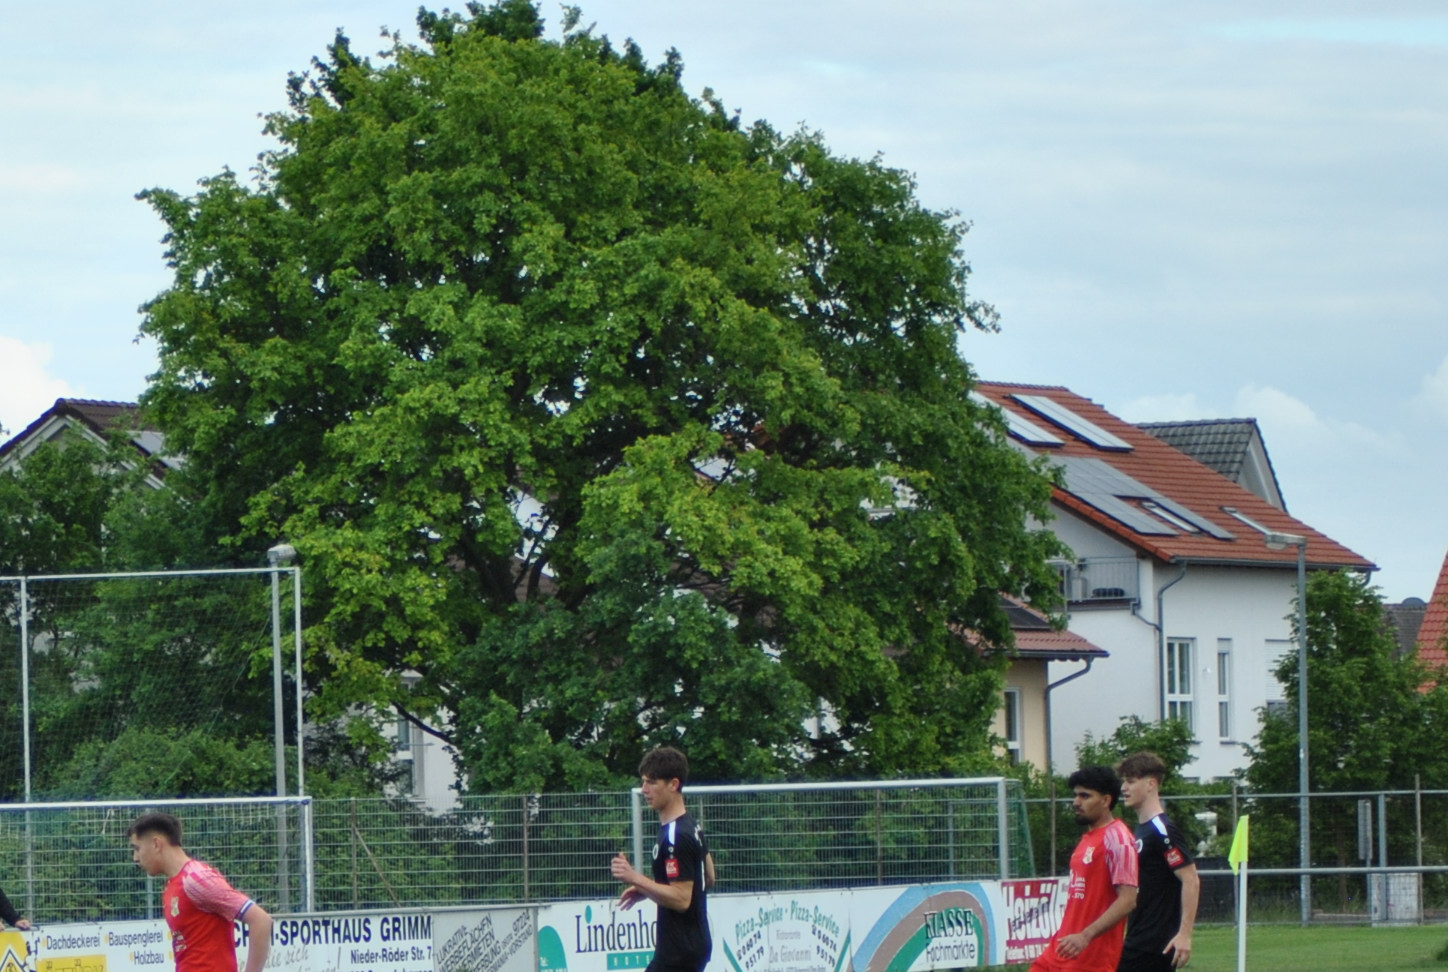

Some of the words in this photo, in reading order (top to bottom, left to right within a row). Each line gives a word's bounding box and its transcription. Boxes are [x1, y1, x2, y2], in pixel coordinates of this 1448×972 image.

[380, 915, 431, 942] GRIMM
[575, 905, 657, 954] Lindenho
[735, 904, 784, 945] Pizza-Service
[790, 900, 840, 938] Pizza-Service
[923, 908, 974, 939] KLASSE
[46, 934, 101, 950] Dachdeckerei
[108, 930, 163, 948] Bauspenglerei
[925, 939, 976, 963] Fachmärkte
[134, 950, 164, 965] Holzbau
[350, 948, 409, 964] Nieder-Röder
[411, 946, 425, 961] Str.
[426, 945, 432, 960] 7
[613, 954, 651, 967] HOTE
